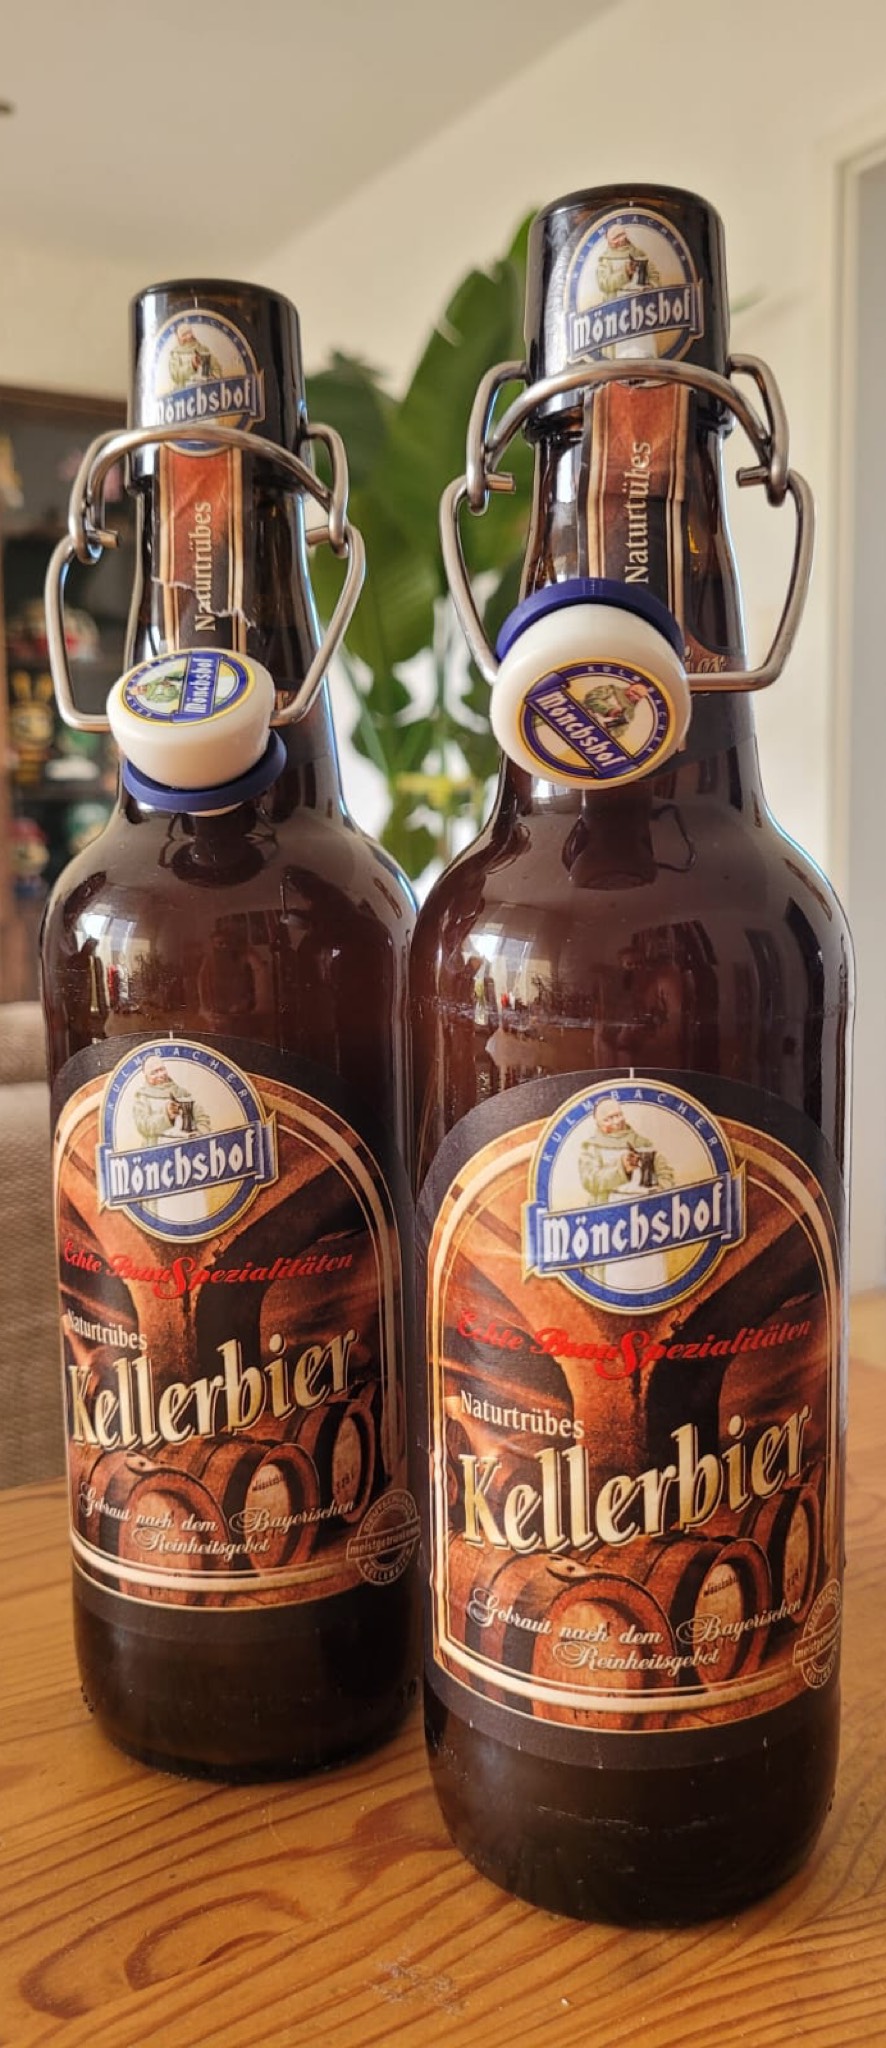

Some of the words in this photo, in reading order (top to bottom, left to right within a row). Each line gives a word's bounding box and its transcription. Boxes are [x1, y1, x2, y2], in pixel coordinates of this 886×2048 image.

[573, 288, 690, 351] Mönchshof
[188, 501, 216, 631] Naturtrübes
[183, 657, 215, 714] Mönchshof
[535, 690, 627, 767] Mönchshof
[108, 1047, 250, 1110] KULMBACHER
[542, 1089, 718, 1162] KULMBACHER
[110, 1128, 256, 1197] Mönchshof
[542, 1182, 723, 1263] Mönchshof
[64, 1238, 102, 1272] Echte
[67, 1308, 148, 1350] Naturtrübes
[457, 1308, 524, 1350] Echte
[67, 1328, 359, 1451] Kellerbier
[460, 1389, 585, 1439] Naturtrübes
[79, 1481, 131, 1522] Gebraut
[136, 1512, 175, 1532] nach
[181, 1513, 218, 1532] dem
[228, 1499, 354, 1534] Bayerischen
[458, 1405, 812, 1554] Kellerbier
[131, 1526, 271, 1561] Reinheitsgebot
[466, 1587, 552, 1634] Gebraut
[559, 1622, 609, 1643] nach
[618, 1624, 663, 1645] dem
[675, 1597, 801, 1645] Bayerischen
[552, 1640, 720, 1677] Reinheitsgebot
